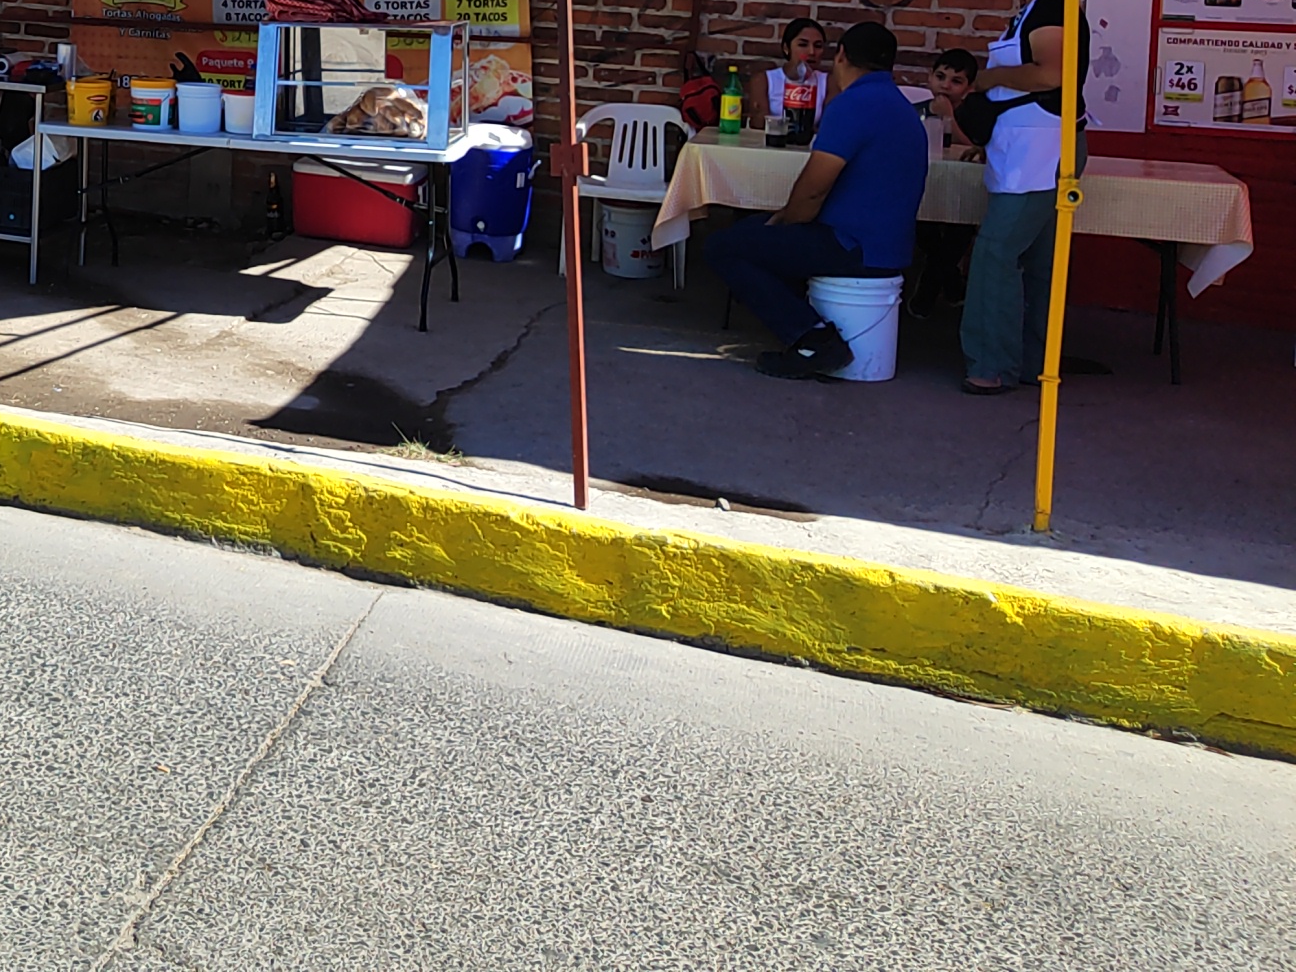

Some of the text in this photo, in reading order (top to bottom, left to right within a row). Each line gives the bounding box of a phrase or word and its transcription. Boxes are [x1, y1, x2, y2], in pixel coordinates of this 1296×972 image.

[221, 0, 265, 9] 4 TORTA
[374, 0, 430, 10] 6 TORTAS
[456, 0, 463, 9] 7
[102, 8, 182, 22] Tortas Ahogadas
[225, 12, 232, 22] 8
[456, 12, 508, 22] 20 TACOS
[119, 28, 126, 36] Y
[128, 27, 172, 39] Carnitas
[1166, 36, 1292, 50] COMPARTIENDO CALIDAD Y
[202, 56, 244, 69] Paquete
[1174, 61, 1194, 76] 2x
[1168, 77, 1198, 92] $46
